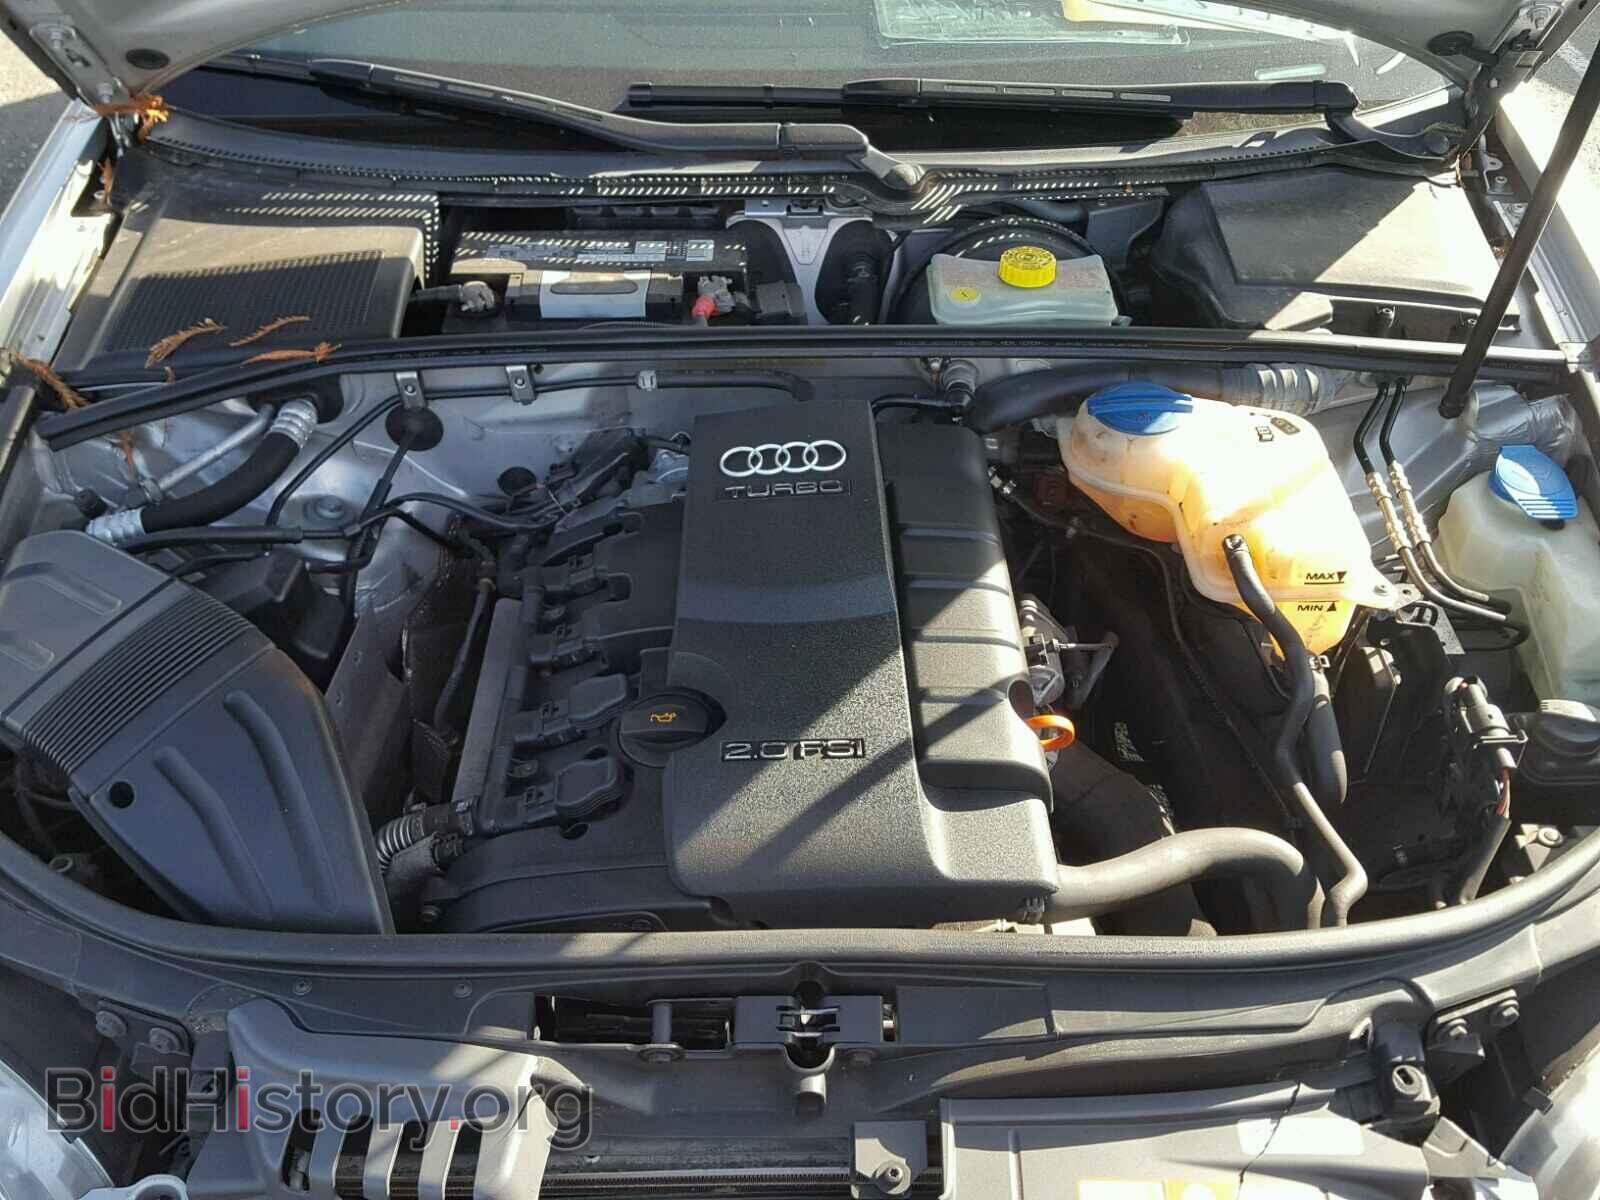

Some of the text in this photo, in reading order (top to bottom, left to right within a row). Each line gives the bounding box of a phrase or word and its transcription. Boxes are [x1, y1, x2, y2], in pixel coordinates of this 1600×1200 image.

[724, 480, 843, 499] TURBO
[1305, 572, 1335, 580] MAX
[1297, 604, 1324, 612] MIN
